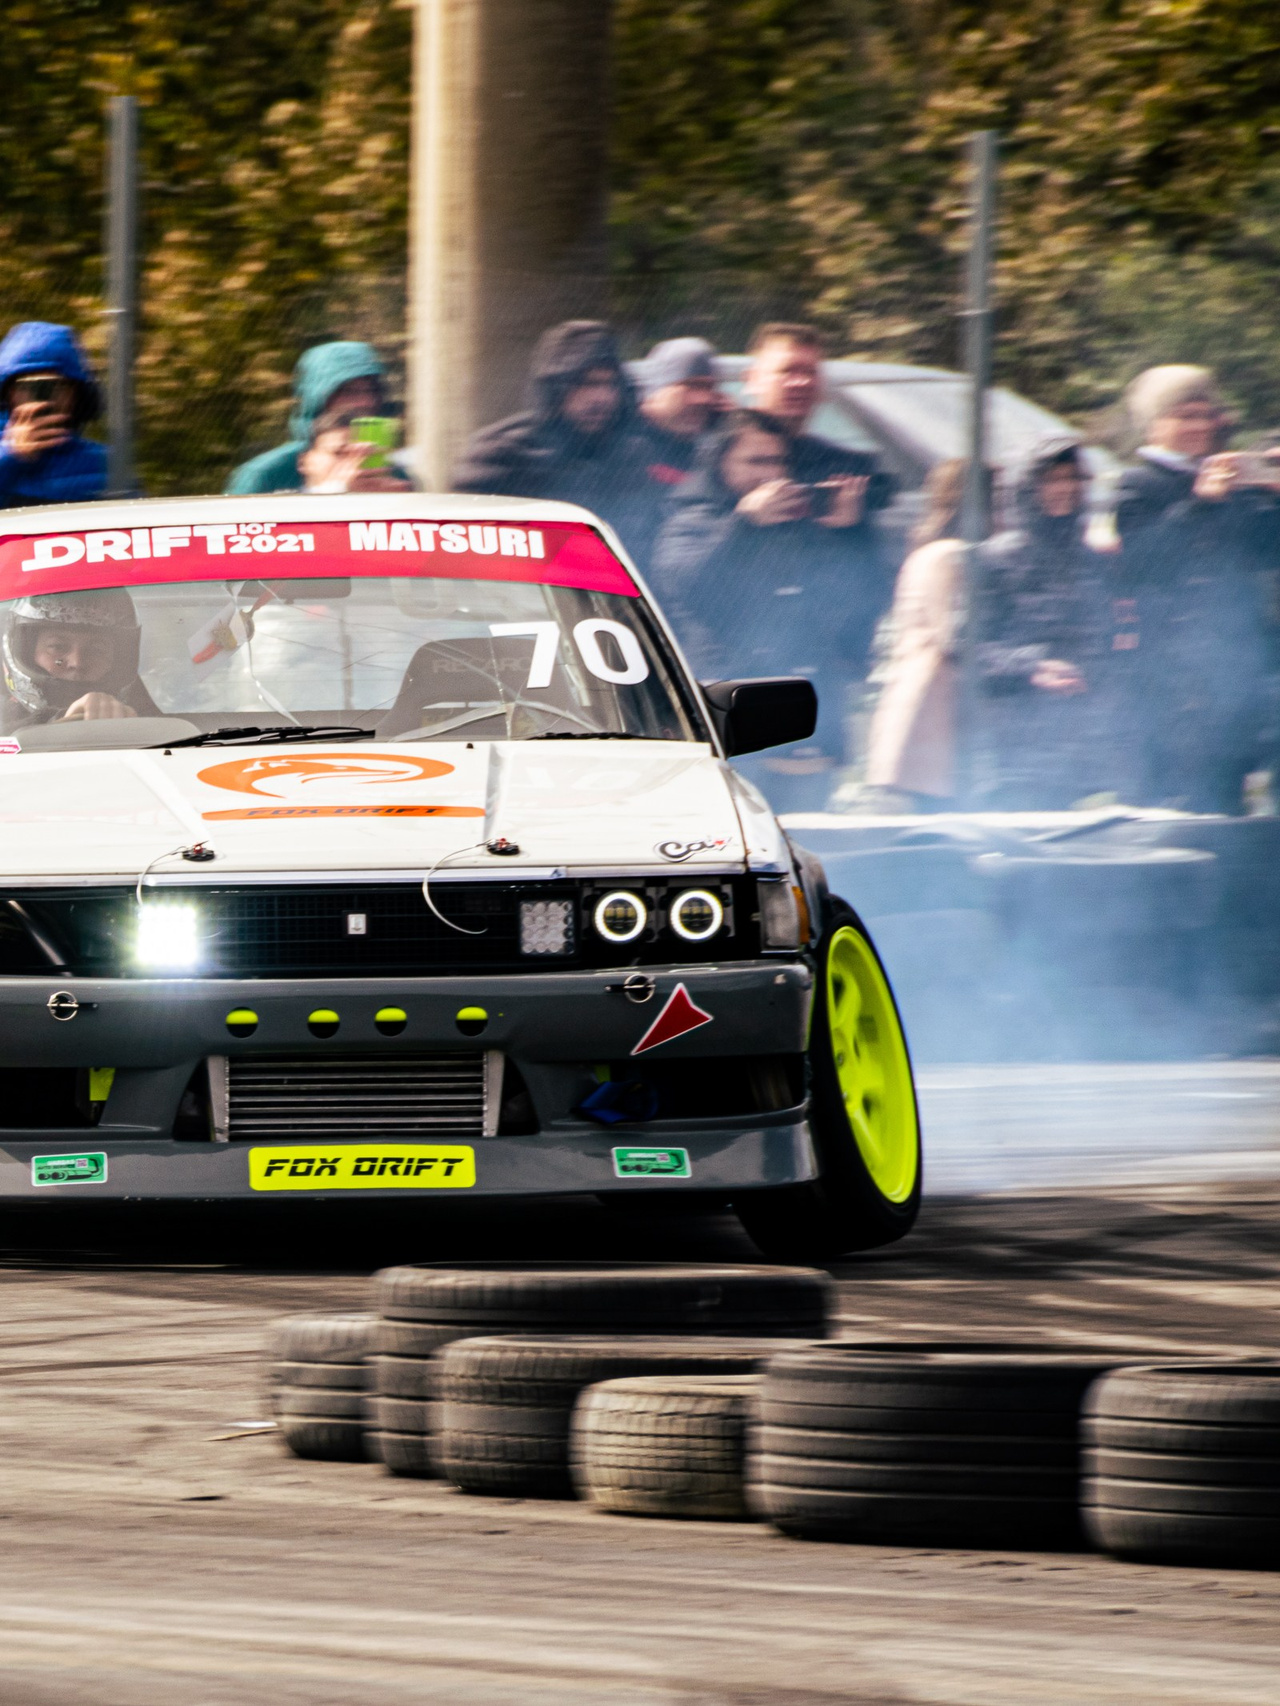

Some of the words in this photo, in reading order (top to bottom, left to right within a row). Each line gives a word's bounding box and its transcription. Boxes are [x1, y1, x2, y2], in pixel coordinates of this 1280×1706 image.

[21, 524, 237, 571] DRIFT
[228, 533, 315, 554] 2021
[349, 522, 545, 559] MATSURI
[489, 618, 650, 688] 70
[247, 807, 319, 816] FOX
[333, 807, 439, 815] DRIFT
[264, 1157, 342, 1177] FOX
[351, 1157, 465, 1177] DRIFT
